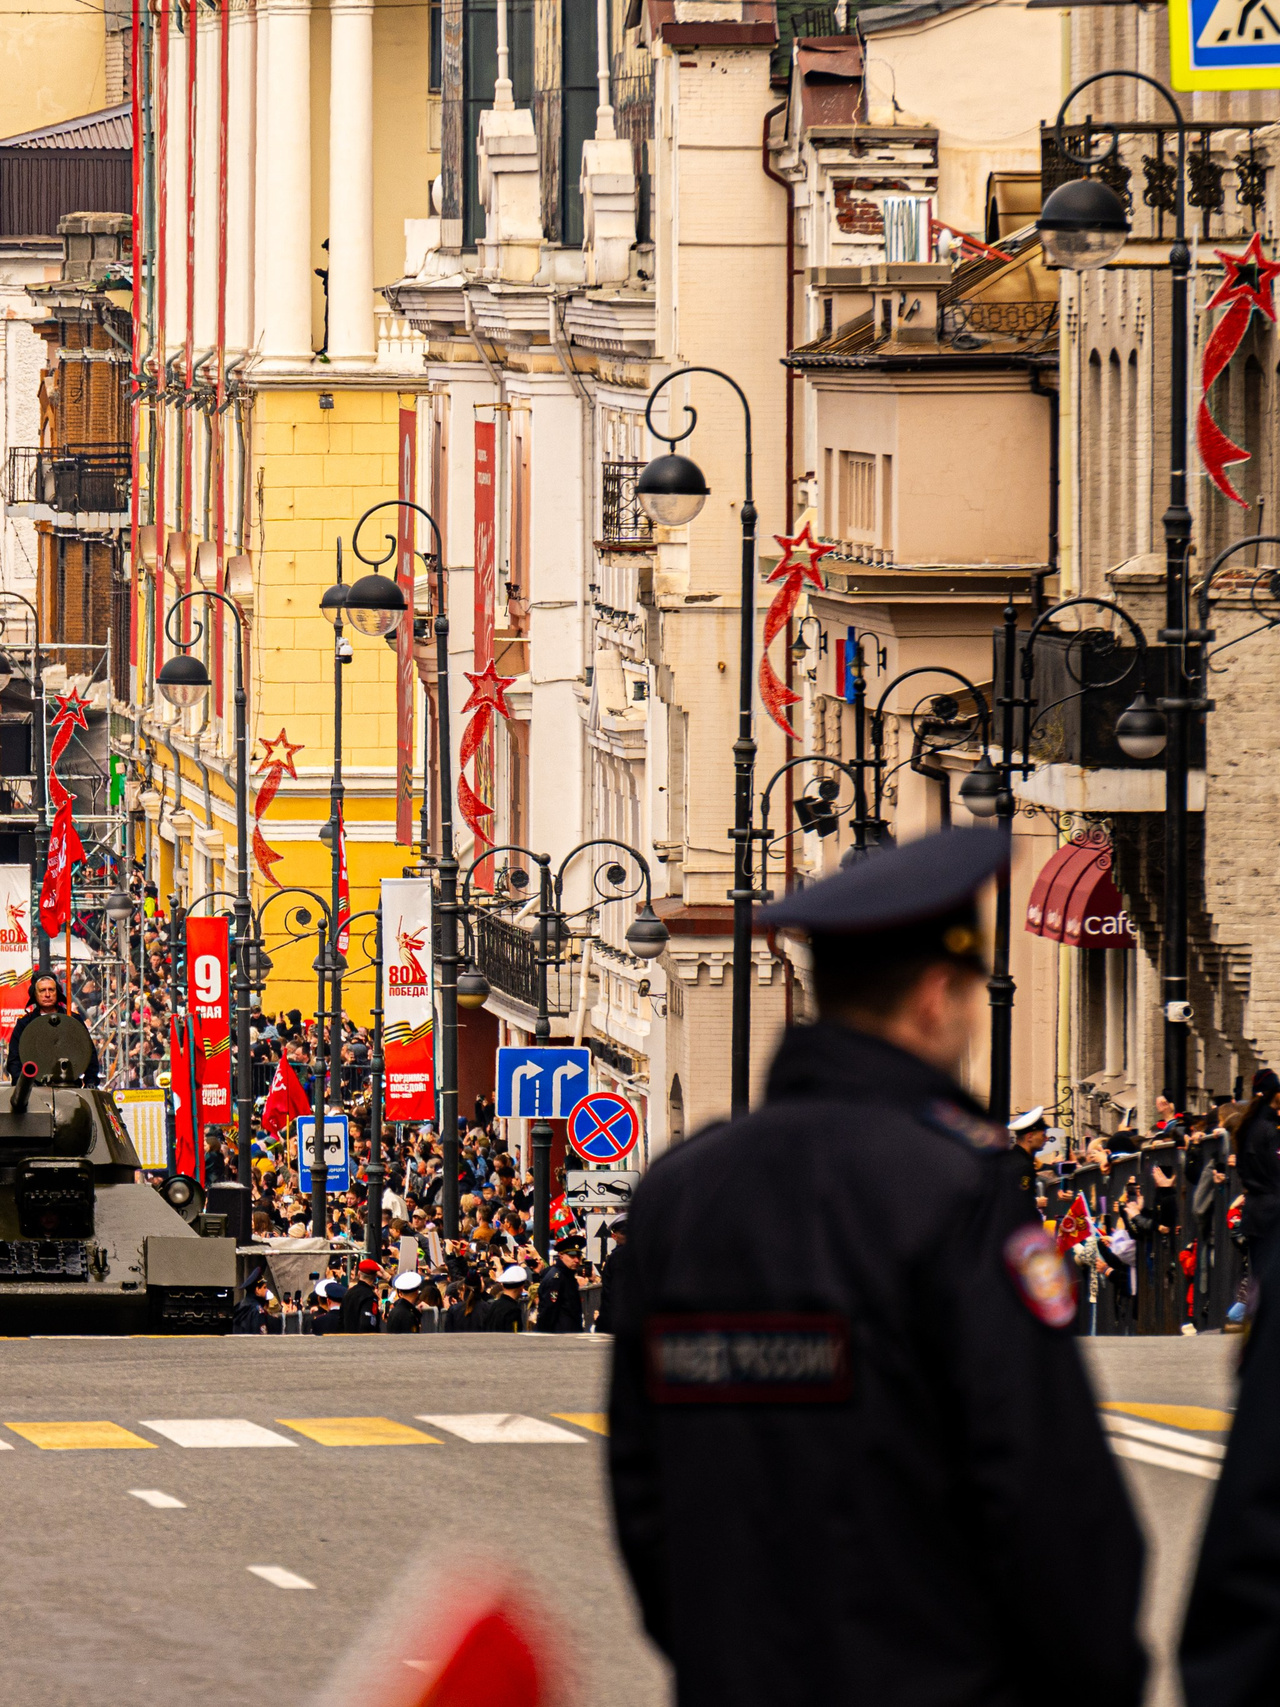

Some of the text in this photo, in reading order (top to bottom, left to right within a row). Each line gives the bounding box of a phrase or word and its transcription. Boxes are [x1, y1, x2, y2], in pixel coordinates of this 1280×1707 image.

[0, 929, 16, 943] 80
[0, 944, 29, 952] ПОБЕДА!
[194, 955, 222, 1003] 9
[389, 965, 411, 984] 80
[389, 986, 429, 997] ПОБЕДА!
[389, 1073, 429, 1083] ГОРДИМСЯ
